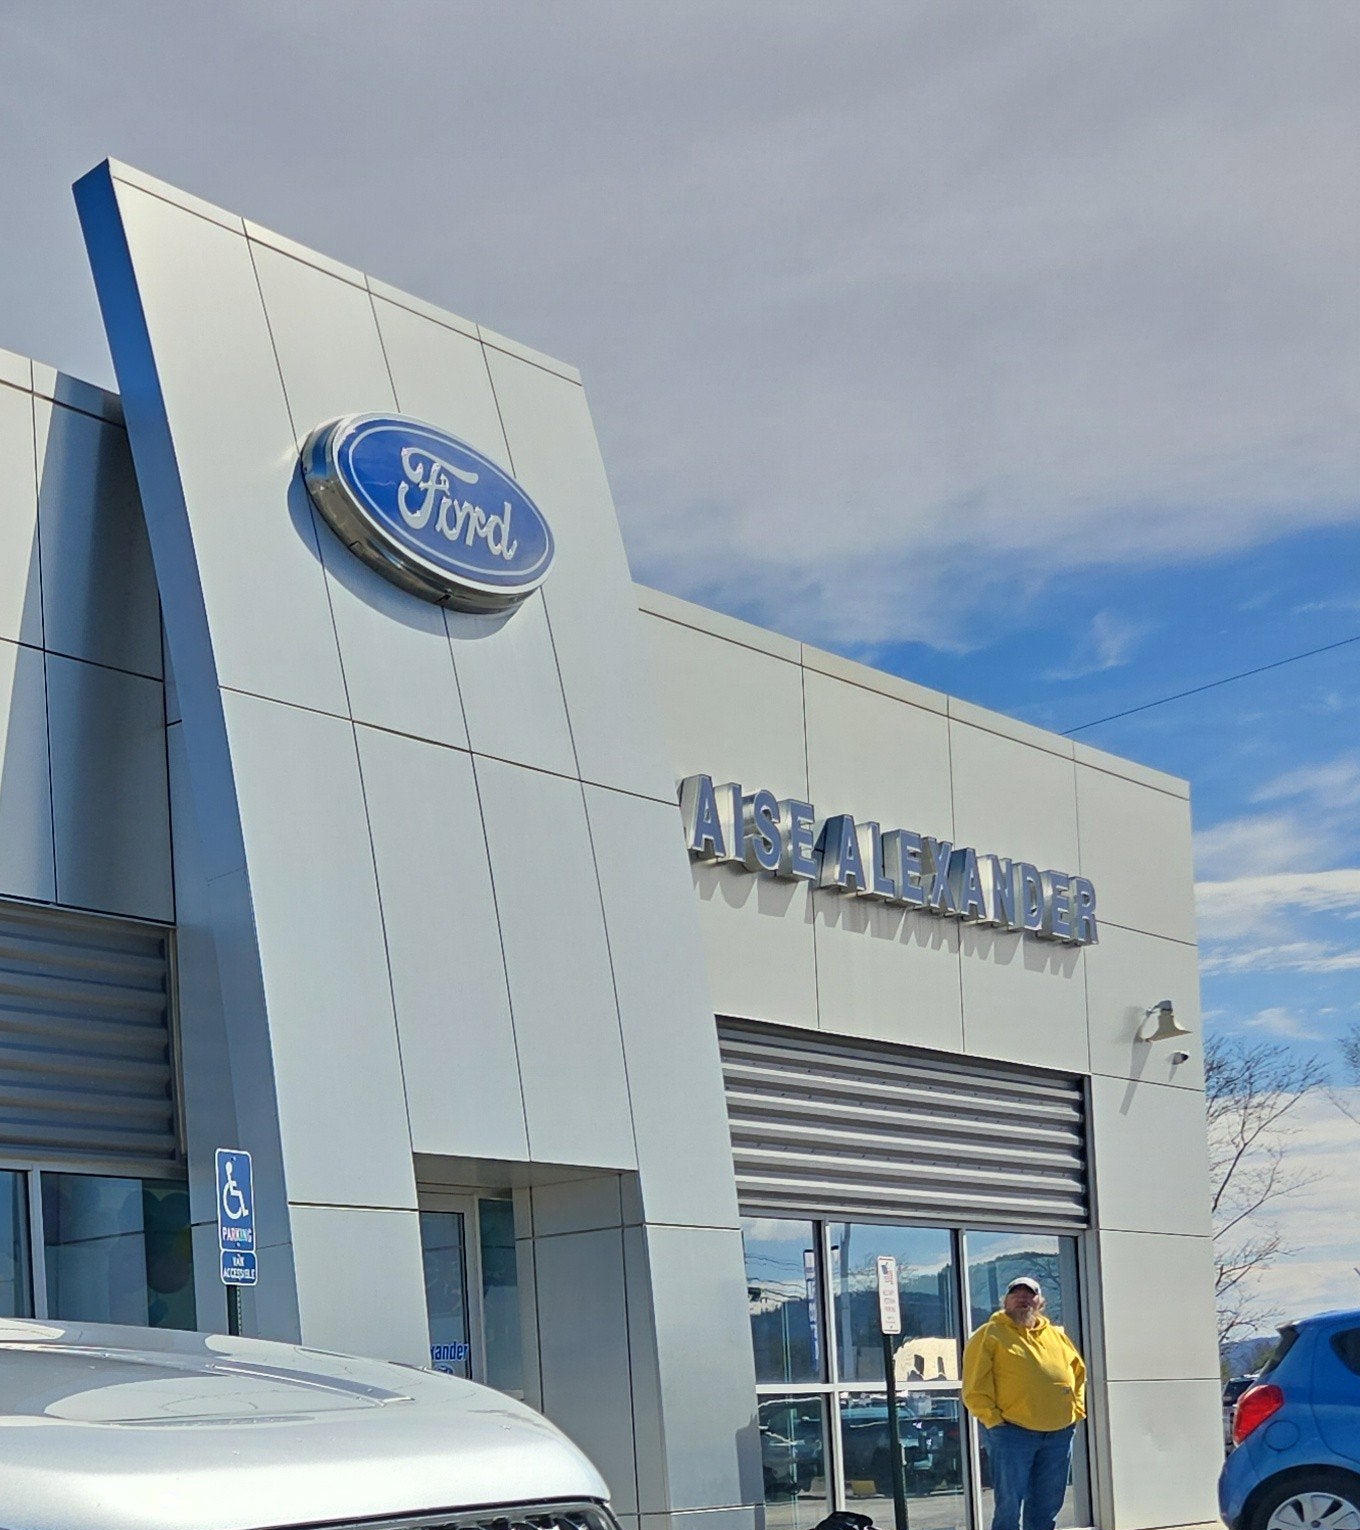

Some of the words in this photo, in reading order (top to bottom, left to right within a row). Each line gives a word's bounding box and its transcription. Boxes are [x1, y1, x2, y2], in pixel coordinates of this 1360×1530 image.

[397, 446, 518, 560] Ford
[814, 813, 1099, 946] ALEXANDER
[222, 1226, 253, 1243] PARKING
